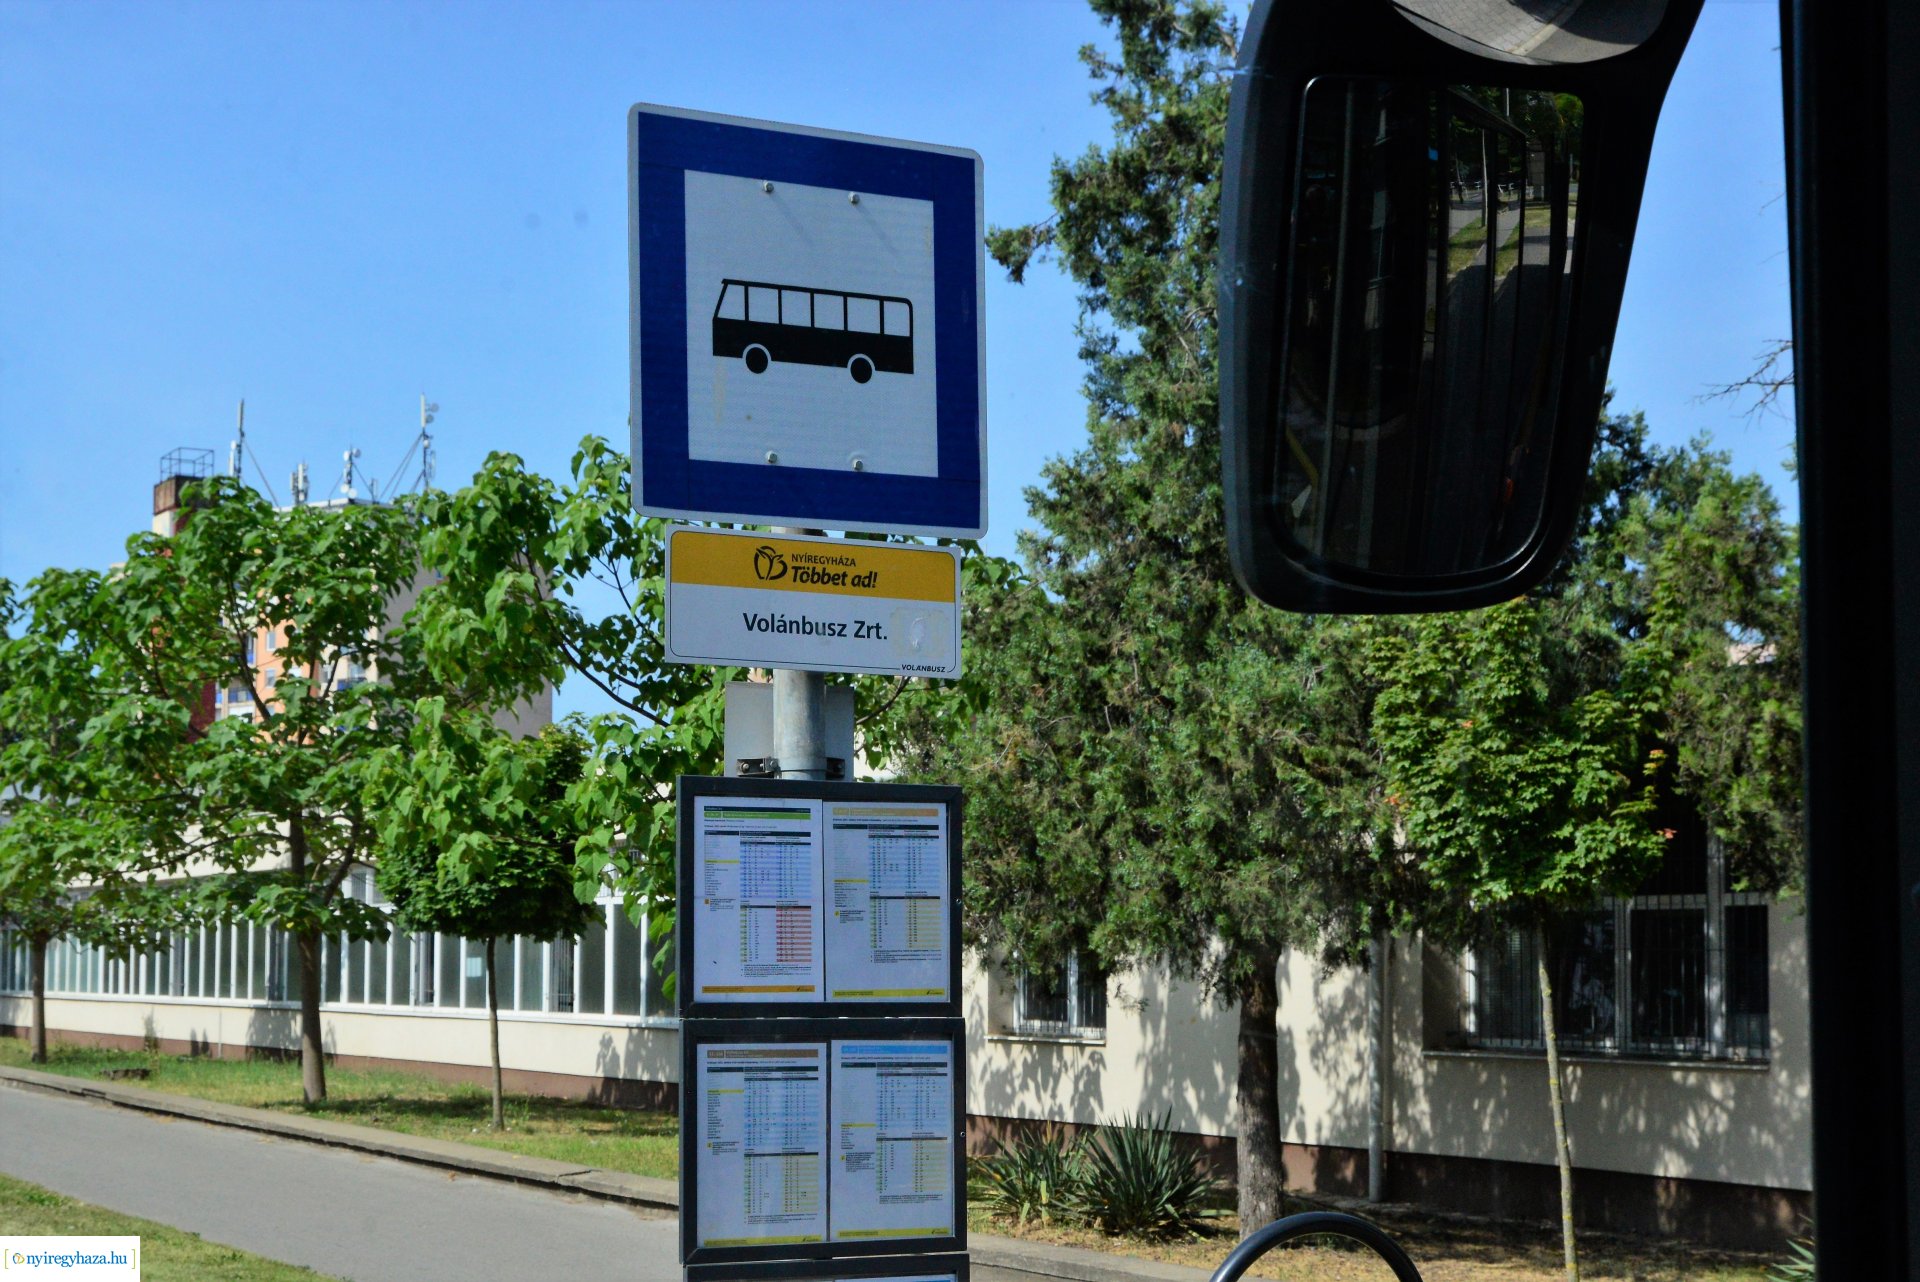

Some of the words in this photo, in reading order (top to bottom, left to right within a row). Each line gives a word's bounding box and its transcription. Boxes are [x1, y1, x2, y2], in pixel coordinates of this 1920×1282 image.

[791, 553, 856, 567] NYÍREGYHÁZA
[791, 566, 848, 587] Többet
[851, 571, 878, 588] ad!
[743, 613, 847, 638] Volánbusz
[853, 620, 888, 640] Zrt.
